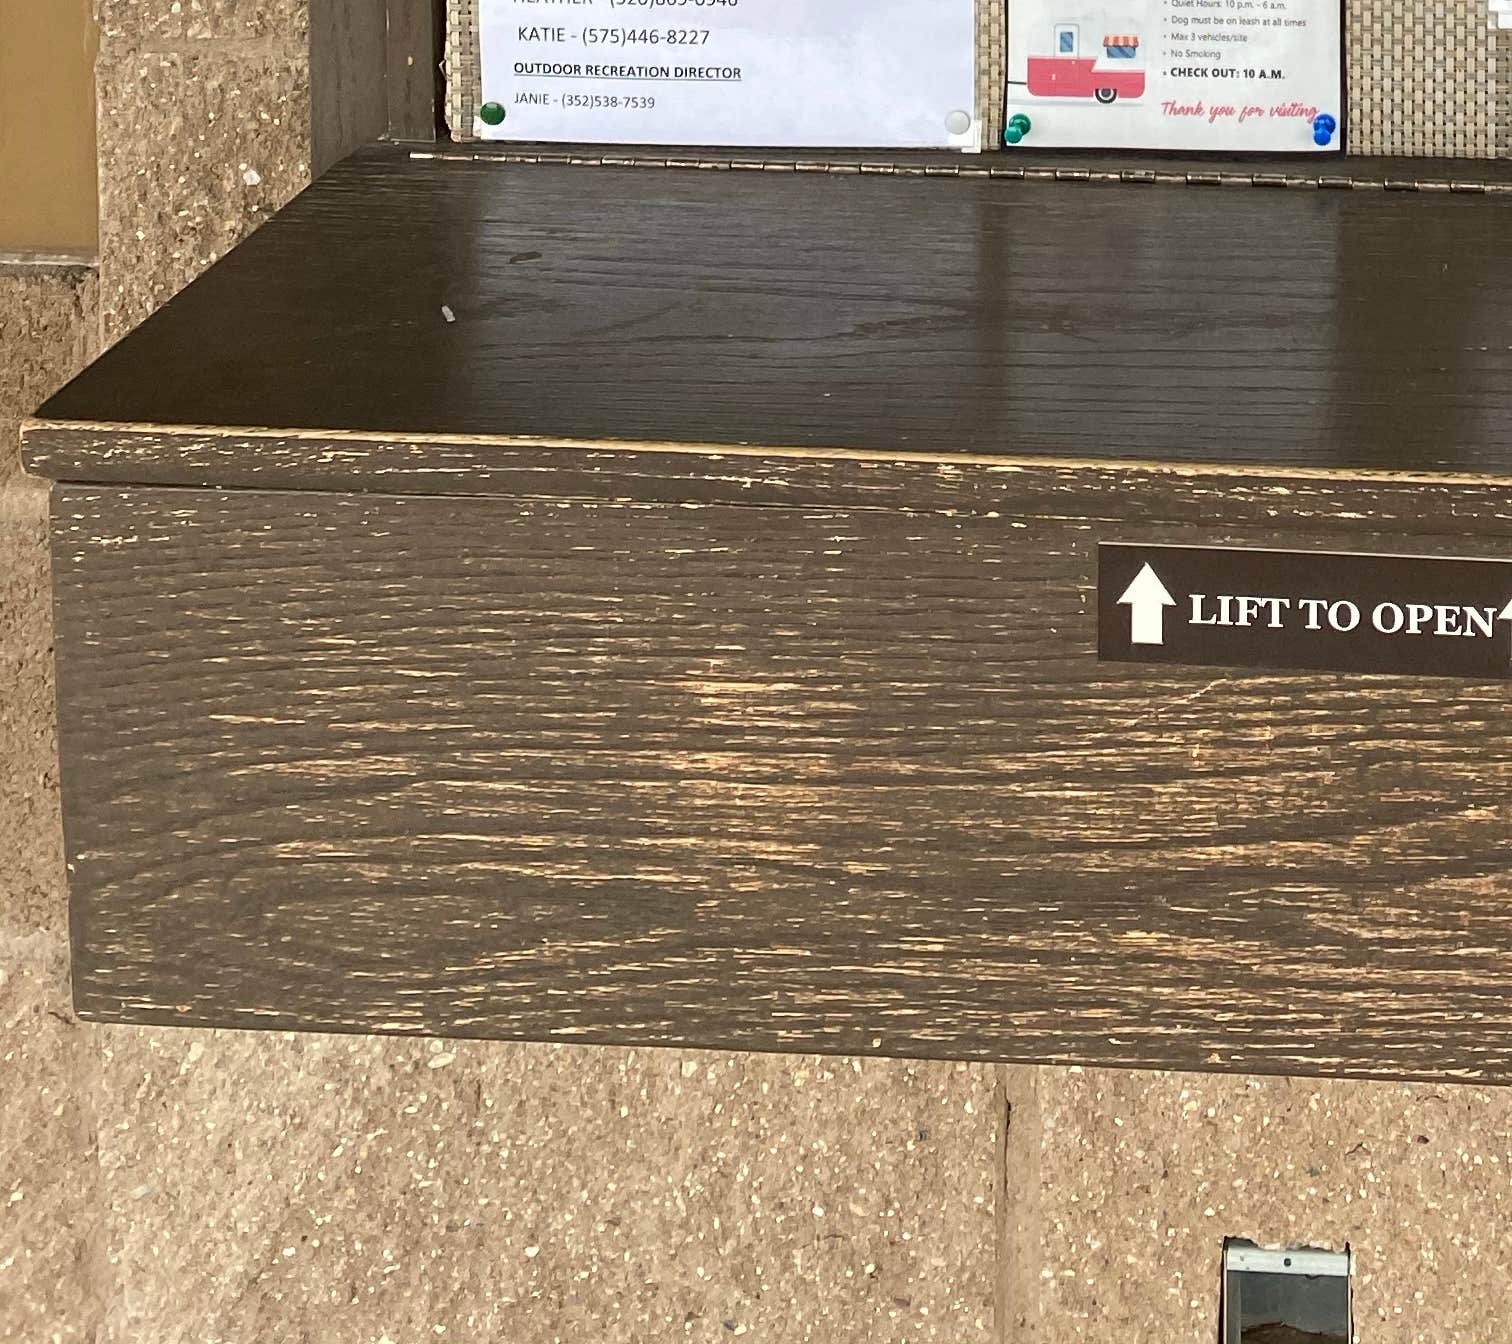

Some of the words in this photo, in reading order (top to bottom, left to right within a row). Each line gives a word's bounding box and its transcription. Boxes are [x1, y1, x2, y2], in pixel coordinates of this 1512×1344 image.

[518, 26, 565, 42] KATIE
[582, 27, 709, 47] (575)446-8227
[1171, 49, 1183, 58] No
[1184, 48, 1221, 60] Smoking
[513, 62, 581, 76] OUTDOOR
[585, 64, 669, 77] RECREATION
[674, 66, 741, 79] DIRECTOR
[1170, 66, 1208, 77] CHECK
[1211, 68, 1239, 78] OUT:
[1243, 68, 1255, 78] 10
[1258, 69, 1285, 79] A.M.
[514, 92, 549, 105] JANIE
[561, 93, 655, 110] (352)538-7539
[1161, 100, 1205, 117] Thank
[1208, 105, 1236, 124] you
[1238, 105, 1265, 123] for
[1269, 102, 1318, 124] visiting
[1188, 593, 1290, 628] LIFT
[1298, 598, 1360, 632] TO
[1371, 601, 1498, 638] OPEN
